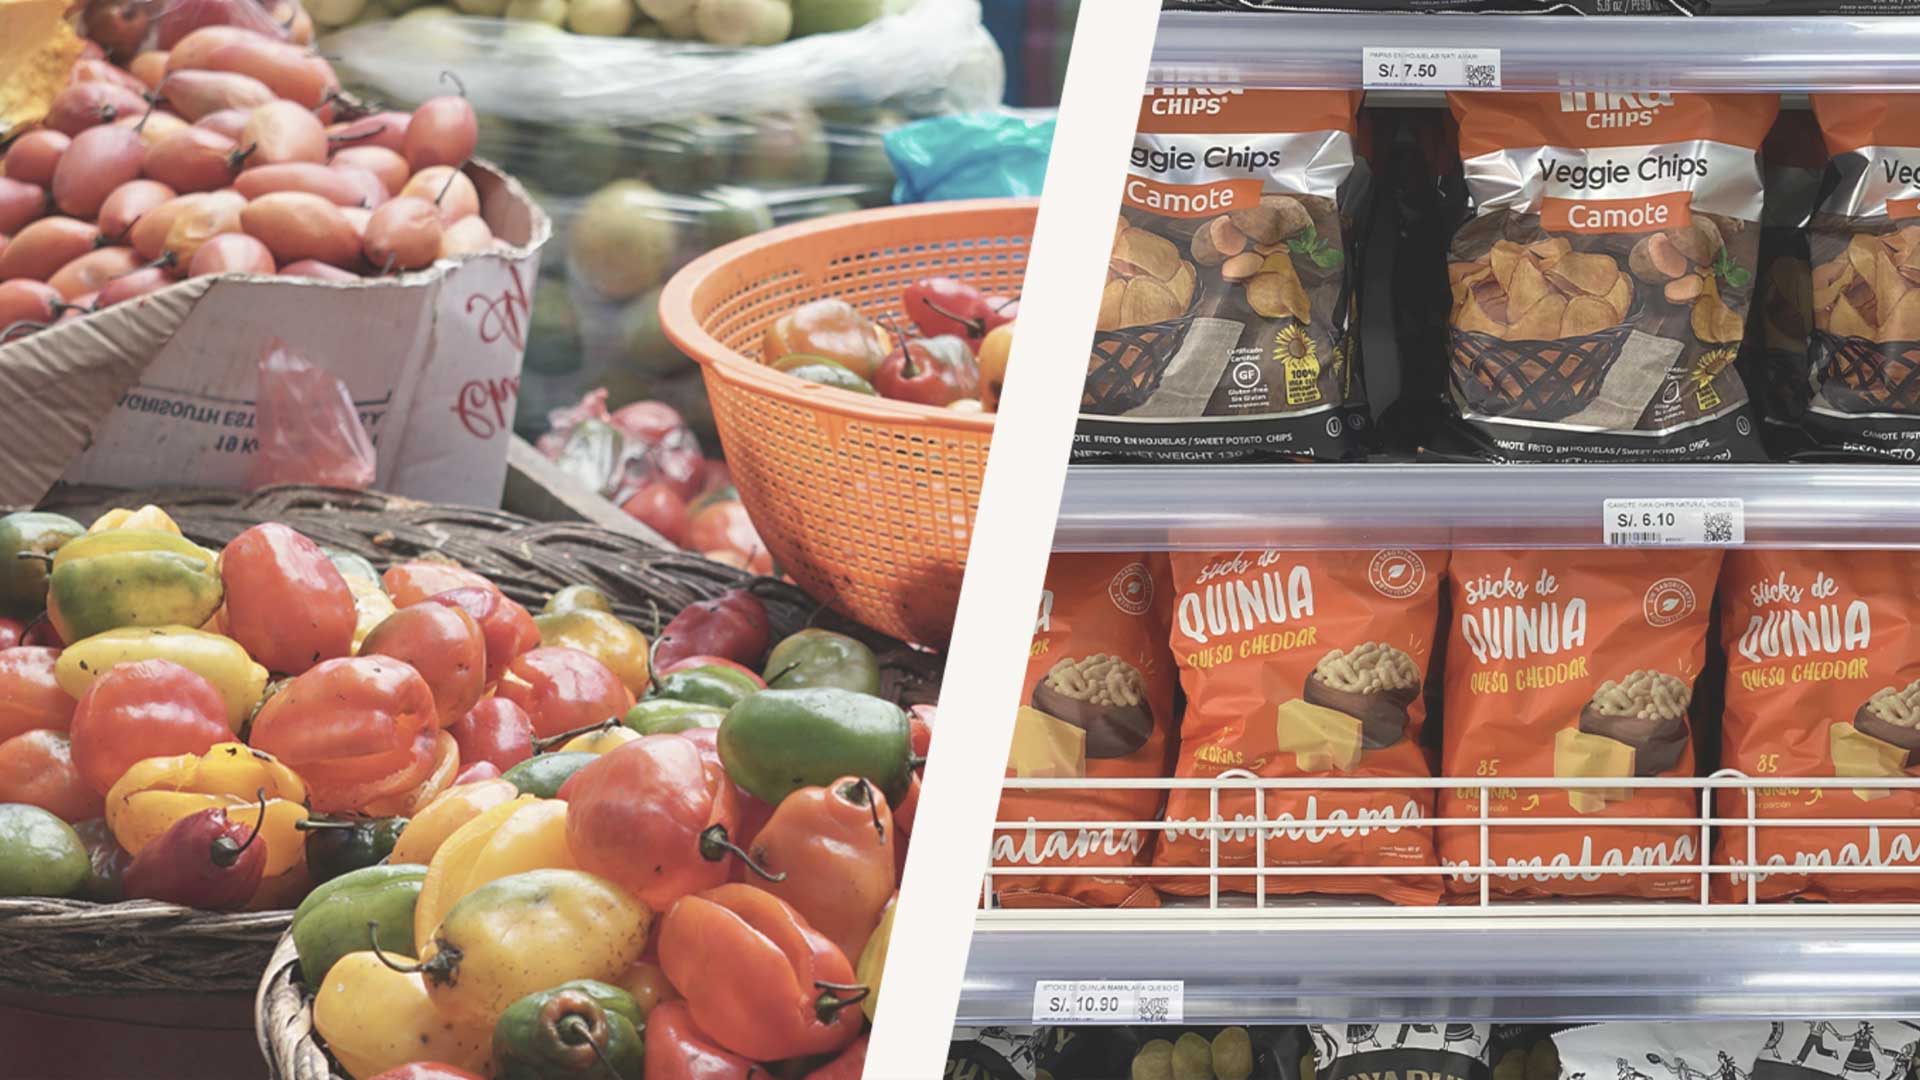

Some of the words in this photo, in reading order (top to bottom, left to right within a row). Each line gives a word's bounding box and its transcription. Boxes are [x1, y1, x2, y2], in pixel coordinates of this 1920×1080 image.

[1378, 63, 1399, 78] S/.
[1404, 63, 1437, 78] 7.50
[1151, 98, 1221, 115] CHIPS
[1586, 110, 1653, 129] CHIPS
[1203, 146, 1280, 172] Chips
[1537, 158, 1631, 190] Veggie
[1637, 153, 1708, 182] Chips
[1127, 181, 1234, 213] Camote
[1567, 203, 1669, 229] Camote
[1239, 369, 1255, 380] GF
[1094, 435, 1121, 444] FRITO
[1124, 437, 1137, 445] EN
[1138, 438, 1187, 446] HOJUELAS
[1193, 437, 1224, 445] SWEET
[1226, 435, 1262, 445] POTATO
[1266, 433, 1293, 444] CHIPS
[1528, 443, 1553, 454] FRITO
[1556, 446, 1568, 454] EN
[1157, 451, 1215, 460] WEIGHT
[1617, 513, 1638, 528] S/.
[1642, 513, 1675, 527] 6.10
[1464, 567, 1530, 604] sticks
[1535, 567, 1560, 597] de
[1750, 570, 1805, 607] sticks
[1811, 571, 1840, 599] de
[1178, 565, 1314, 643] QUINUA
[1462, 597, 1587, 664] QUINUA
[1738, 600, 1872, 664] QUINUA
[1187, 644, 1233, 668] QUESO
[1239, 626, 1318, 659] CHEDDAR
[1470, 672, 1509, 695] QUESO
[1515, 656, 1590, 692] CHEDDAR
[1741, 665, 1786, 692] QUESO
[1791, 657, 1870, 683] CHEDDAR
[1476, 759, 1500, 776] 85
[1757, 754, 1780, 773] 85
[1049, 997, 1070, 1012] S/.
[1076, 996, 1119, 1012] 10.90
